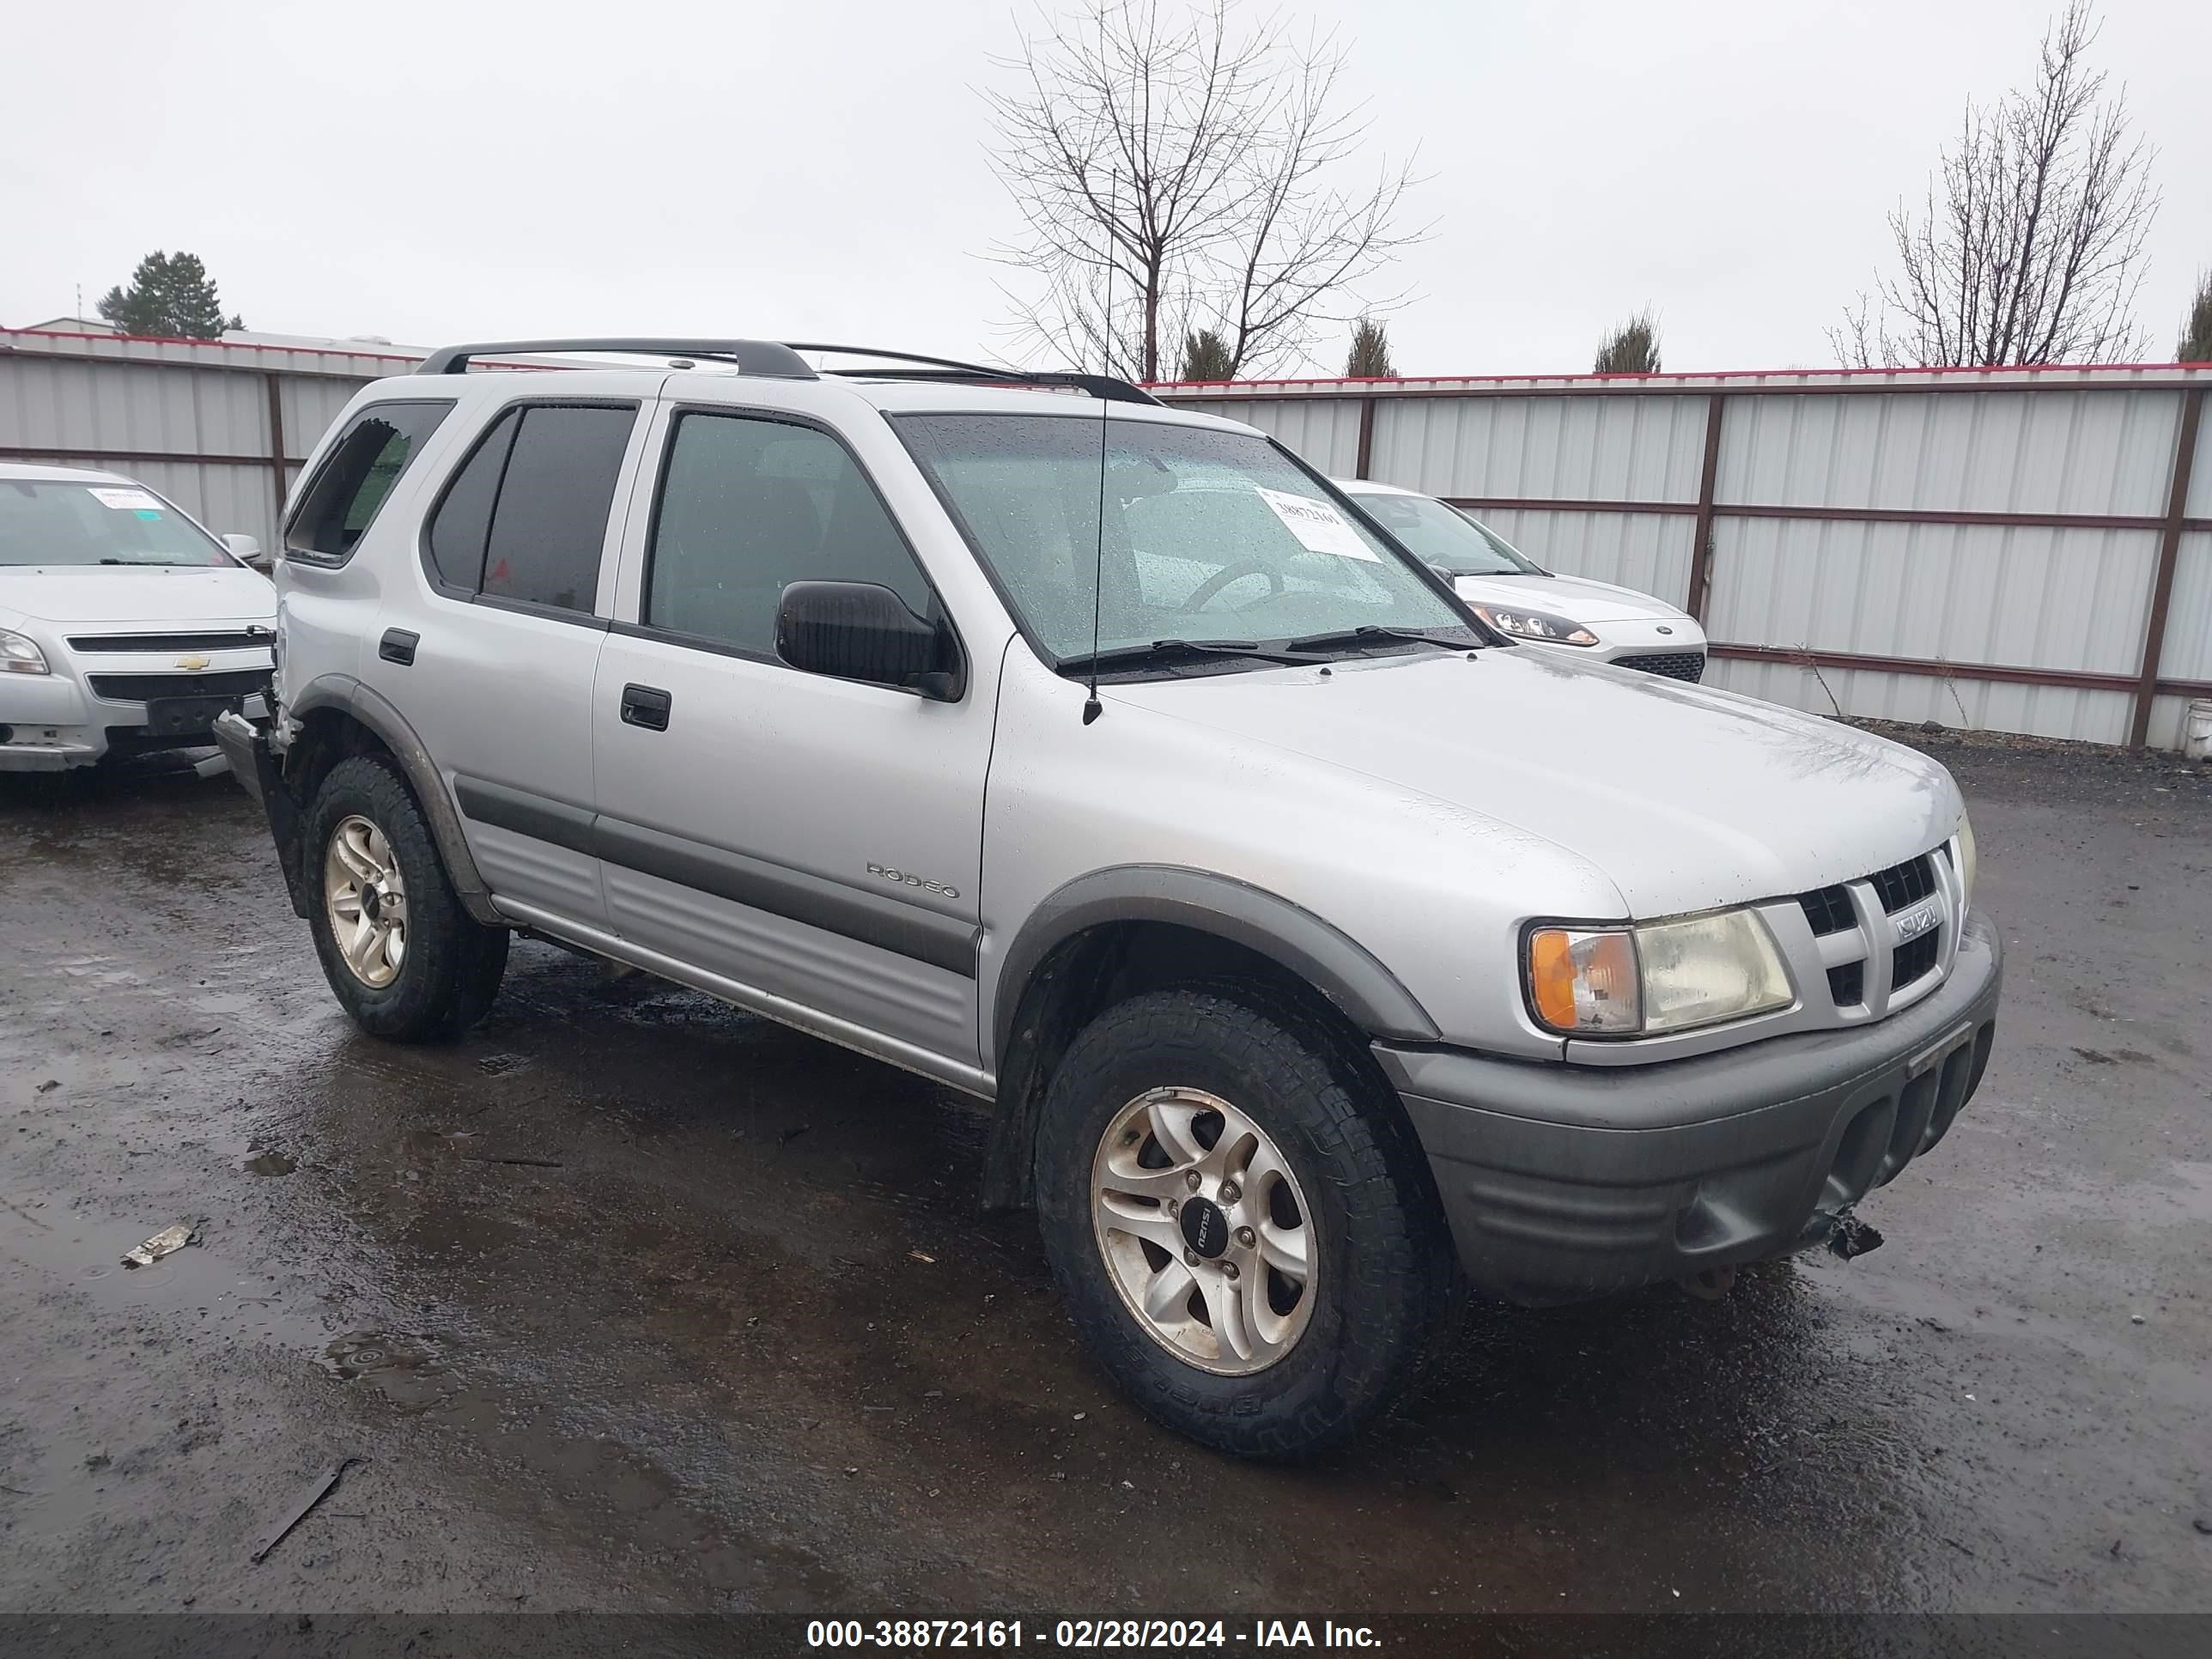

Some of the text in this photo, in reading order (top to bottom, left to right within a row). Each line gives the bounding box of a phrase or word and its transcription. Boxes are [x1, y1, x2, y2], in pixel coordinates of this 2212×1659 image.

[1275, 501, 1340, 526] 38872161
[866, 861, 961, 899] RODEO
[1896, 904, 1937, 942] ISUZU
[1197, 1206, 1212, 1249] ISUZU
